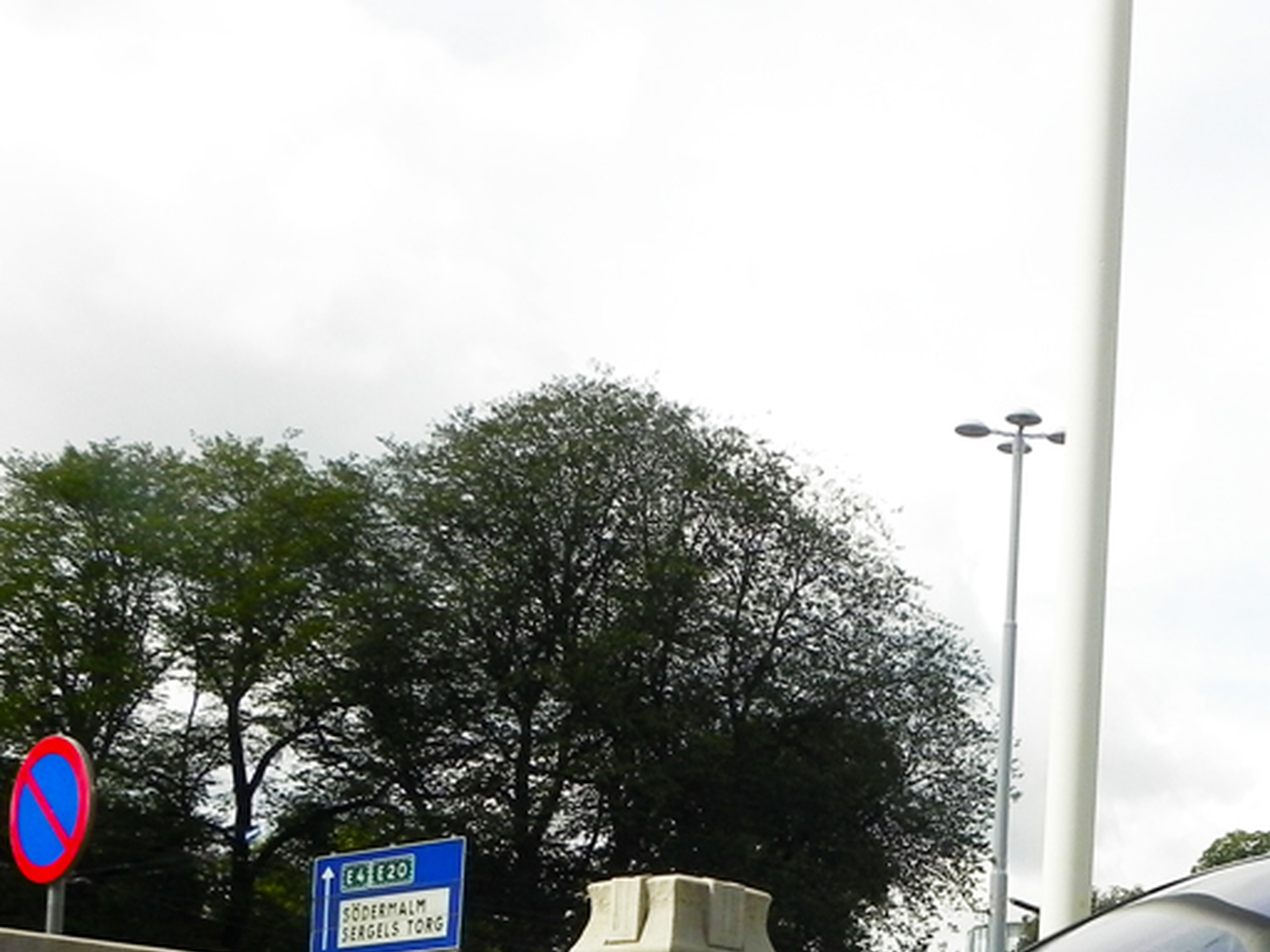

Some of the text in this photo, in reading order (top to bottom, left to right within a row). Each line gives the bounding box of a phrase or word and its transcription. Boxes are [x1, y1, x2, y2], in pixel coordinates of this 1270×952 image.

[346, 862, 408, 884] E4 E20
[342, 899, 426, 923] SÖDERMALM
[342, 916, 443, 943] SERGELS TORG
